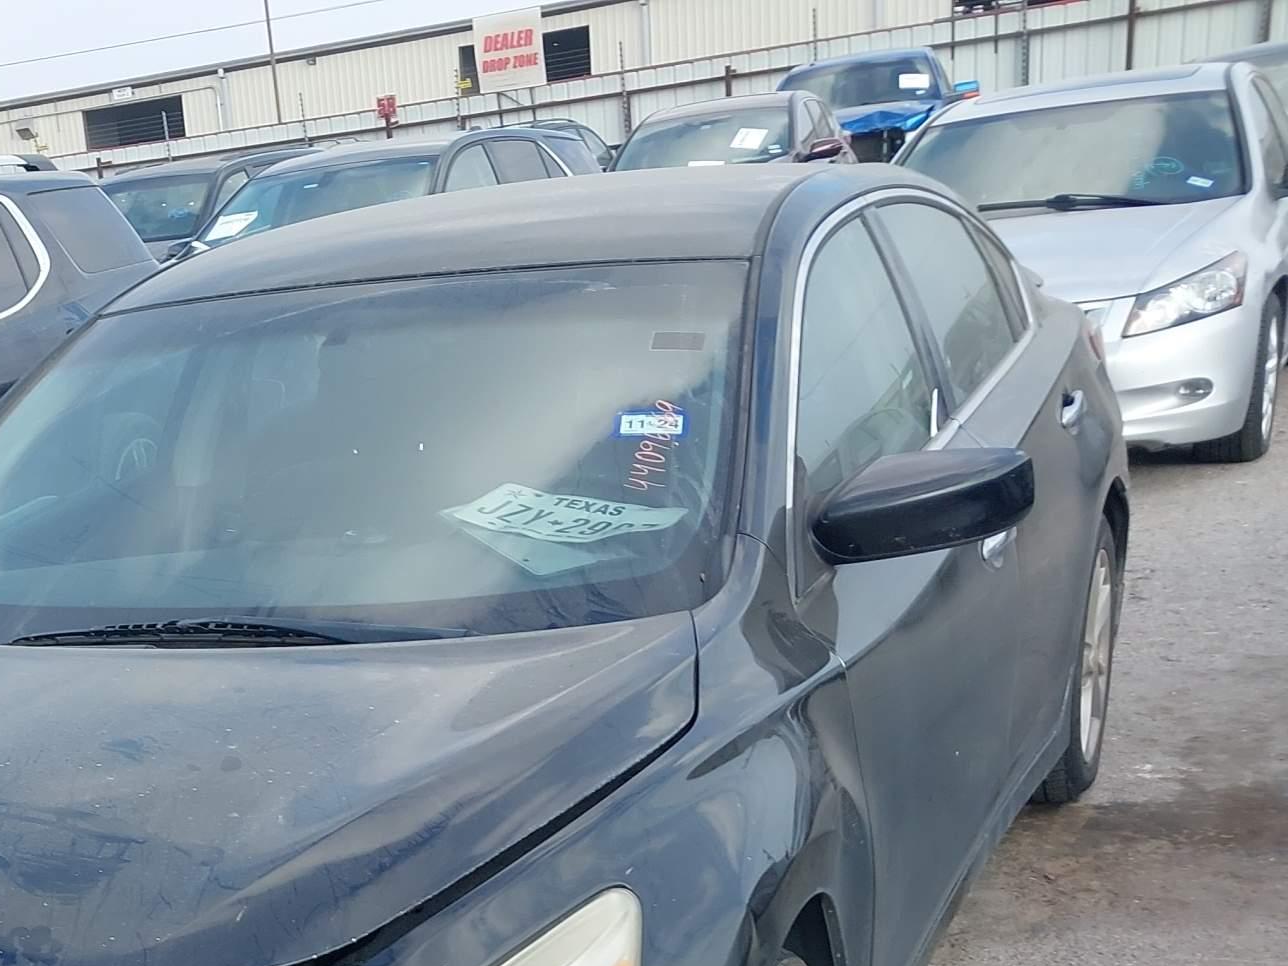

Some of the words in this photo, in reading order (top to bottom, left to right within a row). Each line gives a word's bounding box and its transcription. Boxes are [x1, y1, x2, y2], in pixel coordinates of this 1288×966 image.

[483, 28, 533, 53] DEALER
[481, 56, 511, 73] DROP
[512, 52, 539, 69] ZONE
[552, 497, 626, 516] TEXAS
